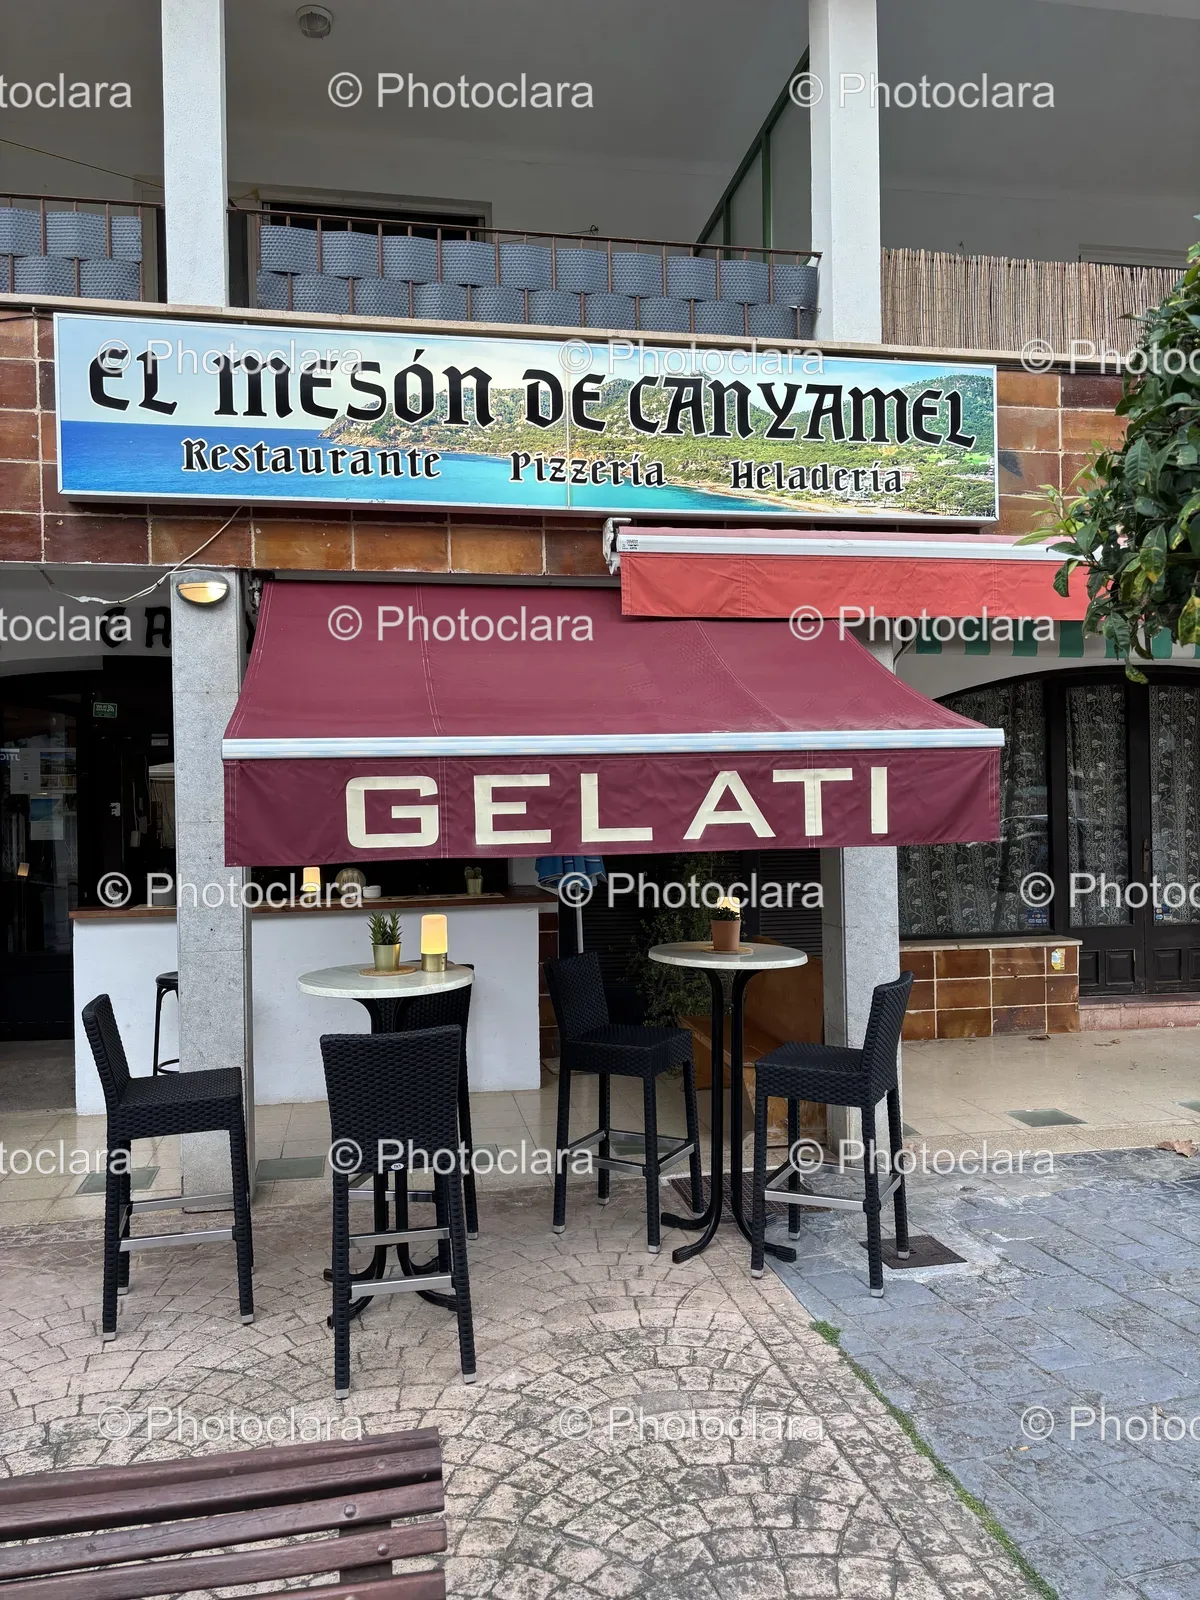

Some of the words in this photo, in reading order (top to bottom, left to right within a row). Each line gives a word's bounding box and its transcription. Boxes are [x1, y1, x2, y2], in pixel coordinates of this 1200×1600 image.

[89, 349, 177, 415] EL
[212, 348, 496, 428] MESÓN
[522, 369, 607, 431] DE
[629, 375, 976, 449] CANYAMEL
[181, 438, 441, 478] Restaurante
[510, 451, 667, 487] Pizzería
[730, 460, 904, 494] Heladería
[346, 766, 888, 849] GELATI
